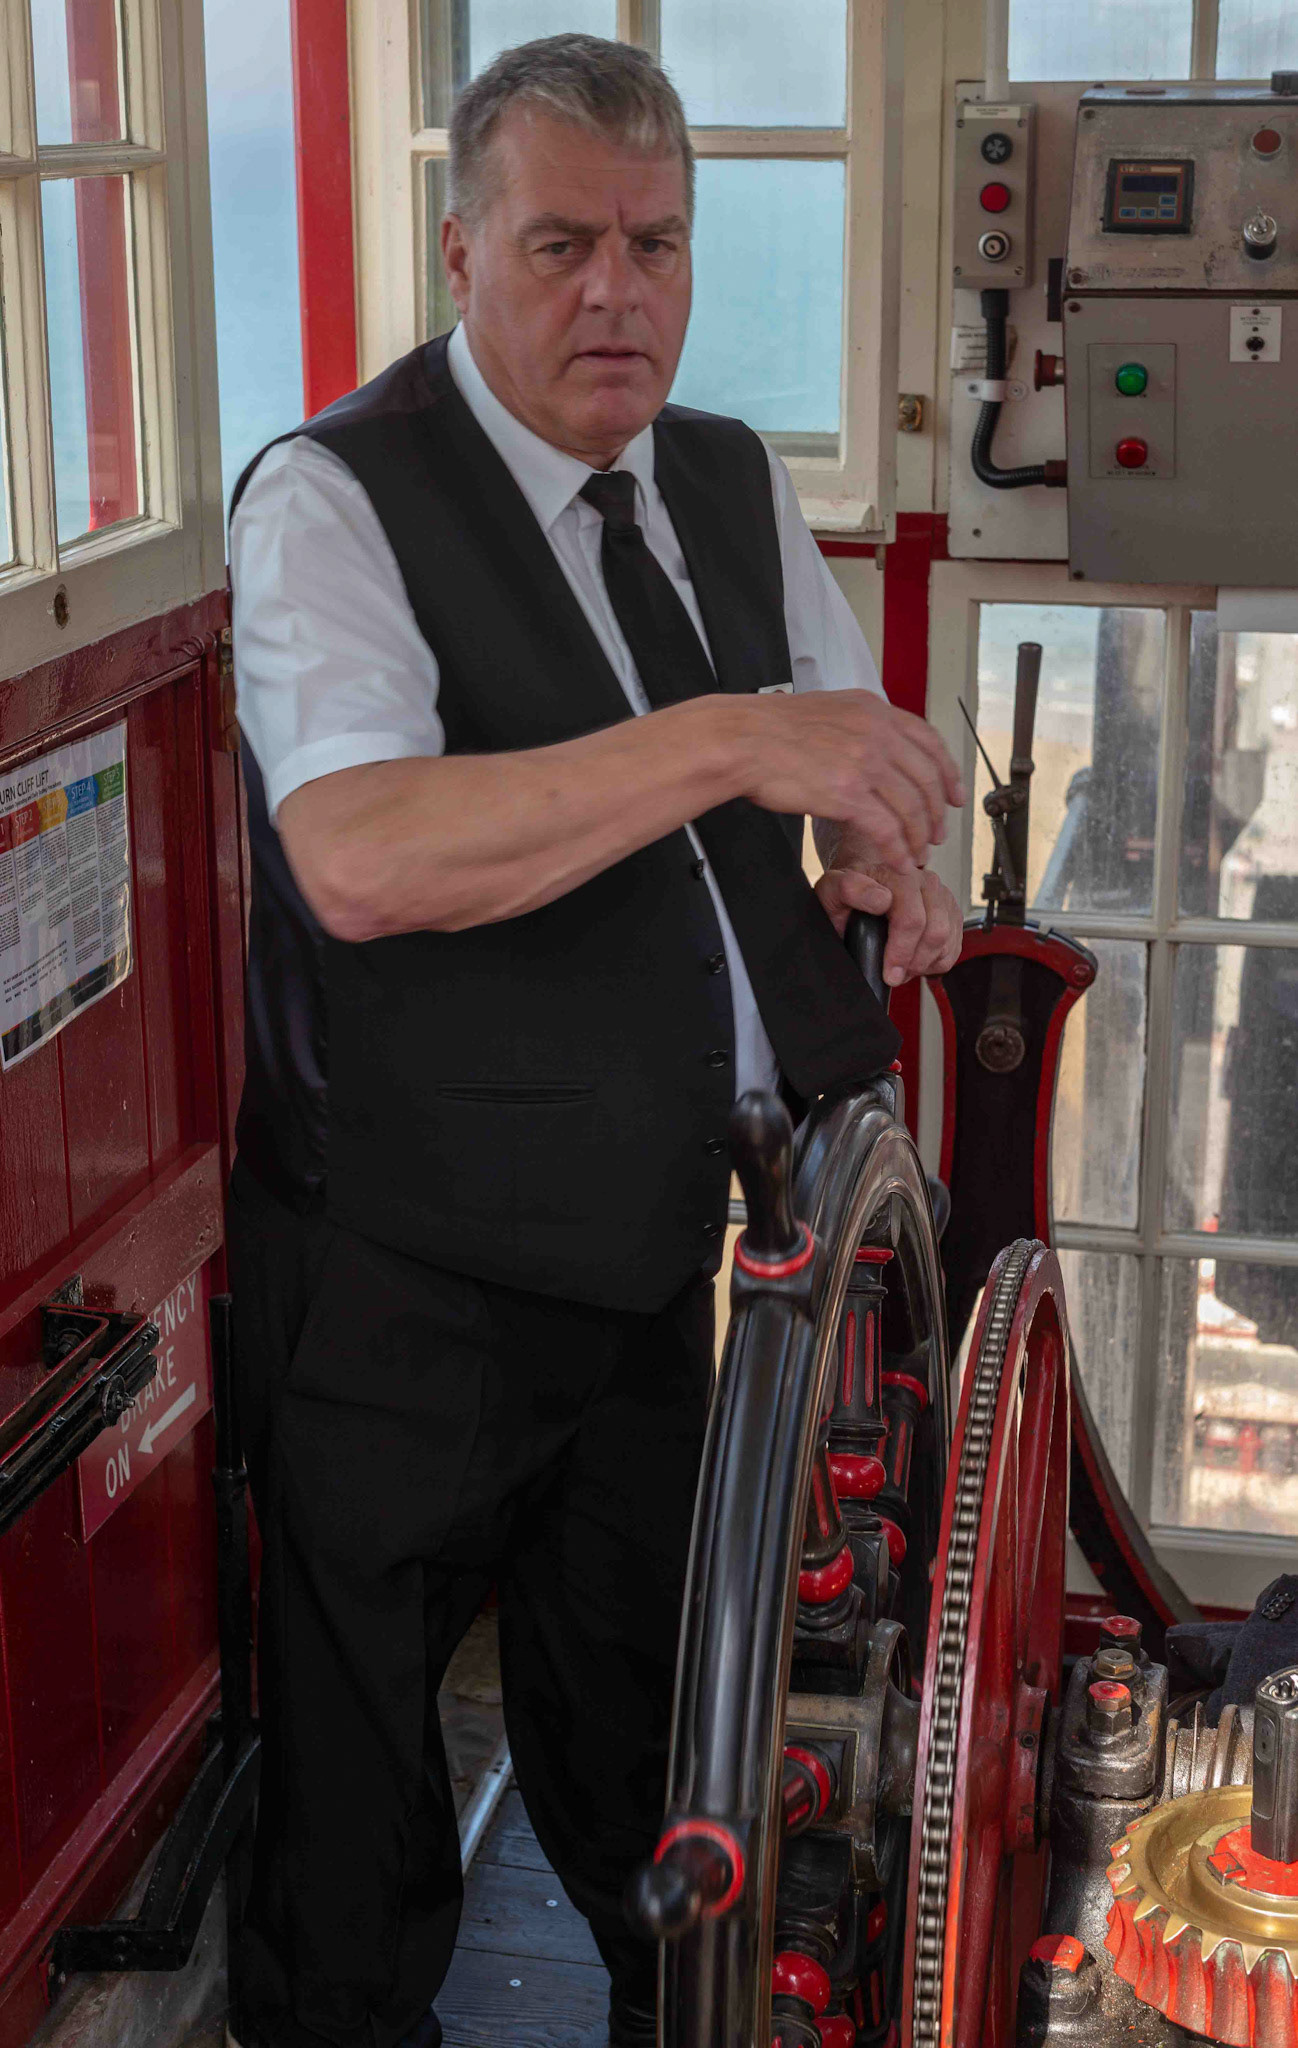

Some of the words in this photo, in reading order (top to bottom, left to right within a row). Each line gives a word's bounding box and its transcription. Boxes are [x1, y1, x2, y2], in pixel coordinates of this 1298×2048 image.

[17, 777, 34, 797] CLIFF
[35, 769, 49, 788] LIFT
[71, 783, 86, 800] STEP
[86, 781, 92, 791] 4
[15, 811, 28, 829] STEP
[105, 1441, 131, 1498] ON
